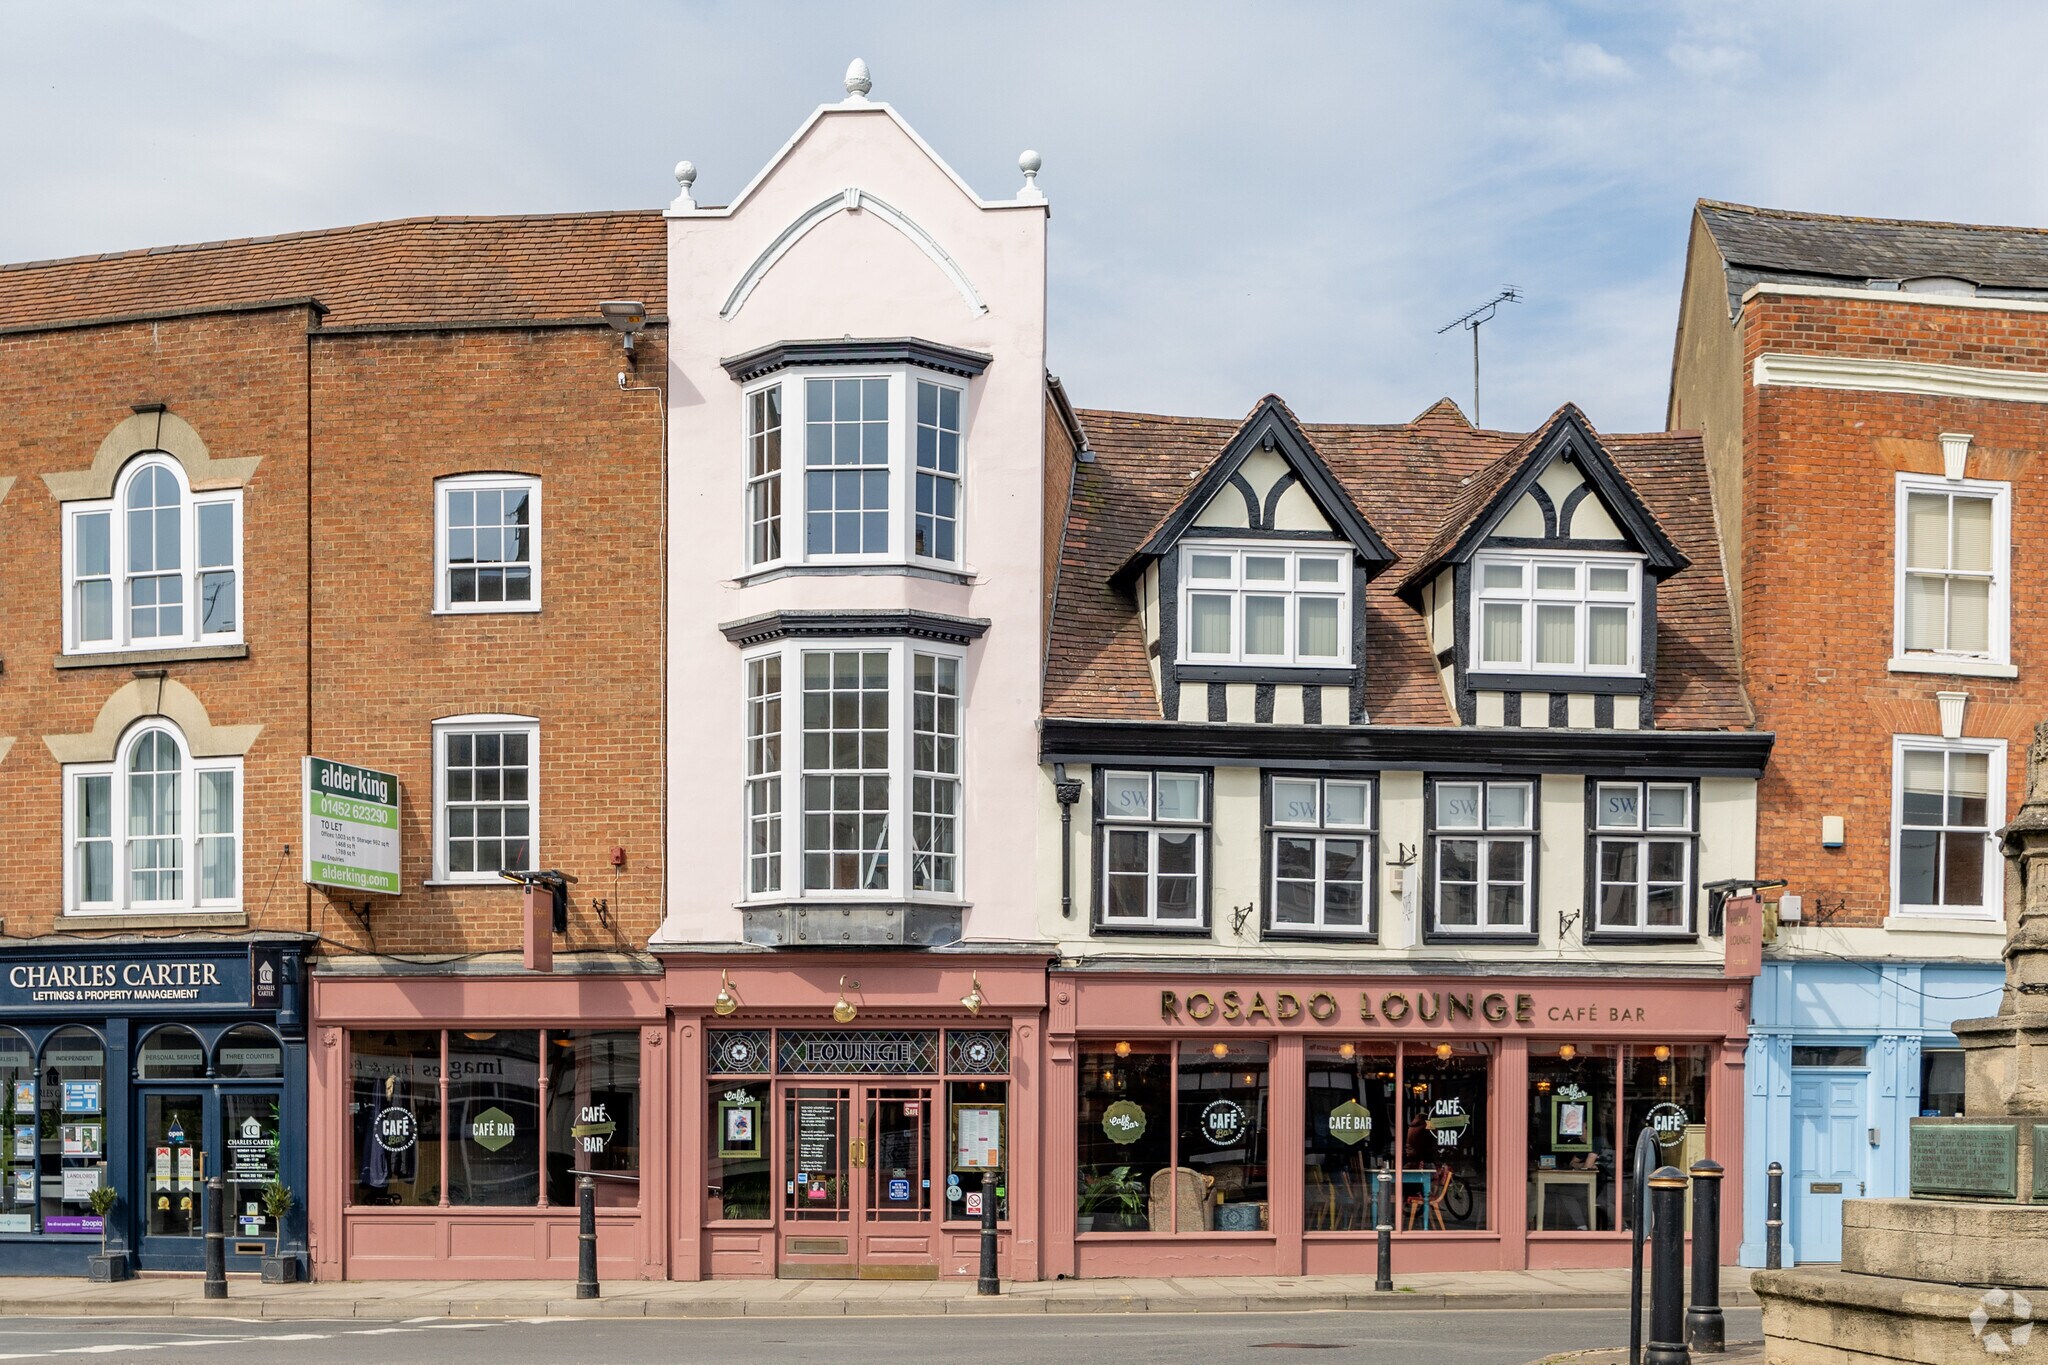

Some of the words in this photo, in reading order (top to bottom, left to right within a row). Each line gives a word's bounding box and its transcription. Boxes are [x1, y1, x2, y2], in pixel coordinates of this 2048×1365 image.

[321, 764, 357, 792] alder
[358, 769, 388, 804] king
[321, 798, 351, 817] 01452
[352, 803, 388, 825] 623290
[321, 820, 330, 830] TO
[330, 821, 343, 832] LET
[321, 866, 389, 887] alderking.com
[10, 964, 117, 989] CHARLES
[122, 963, 221, 986] CARTER
[33, 990, 75, 1001] LETTINGS
[76, 990, 84, 1000] &
[84, 990, 132, 1000] PROPERTY
[134, 989, 199, 1000] MANAGEMENT
[1160, 989, 1337, 1021] ROSADO
[1359, 991, 1533, 1023] LOUNGE
[1547, 1003, 1598, 1022] CAFÉ
[1609, 1006, 1645, 1022] BAR
[176, 1053, 200, 1061] SERVICE
[245, 1052, 275, 1060] COUNTIES
[808, 1043, 909, 1061] LOUNGE
[724, 1088, 747, 1101] Café
[1557, 1083, 1579, 1096] Café
[1569, 1090, 1588, 1100] Bar
[737, 1095, 756, 1106] Bar
[1435, 1096, 1460, 1115] CAFÉ
[581, 1103, 606, 1122] CAFÉ
[1109, 1113, 1131, 1126] Café
[1210, 1109, 1237, 1129] CAFÉ
[1654, 1111, 1681, 1131] CAFÉ
[382, 1116, 409, 1136] CAFÉ
[472, 1119, 495, 1137] CAFÉ
[497, 1122, 515, 1137] BAR
[1121, 1120, 1140, 1131] Bar
[1328, 1113, 1352, 1130] CAFÉ
[1354, 1116, 1372, 1130] BAR
[388, 1135, 406, 1146] Bar
[1215, 1129, 1234, 1139] Bar
[1437, 1129, 1458, 1146] BAR
[583, 1136, 604, 1153] BAR
[66, 1172, 97, 1180] LANDLORDS
